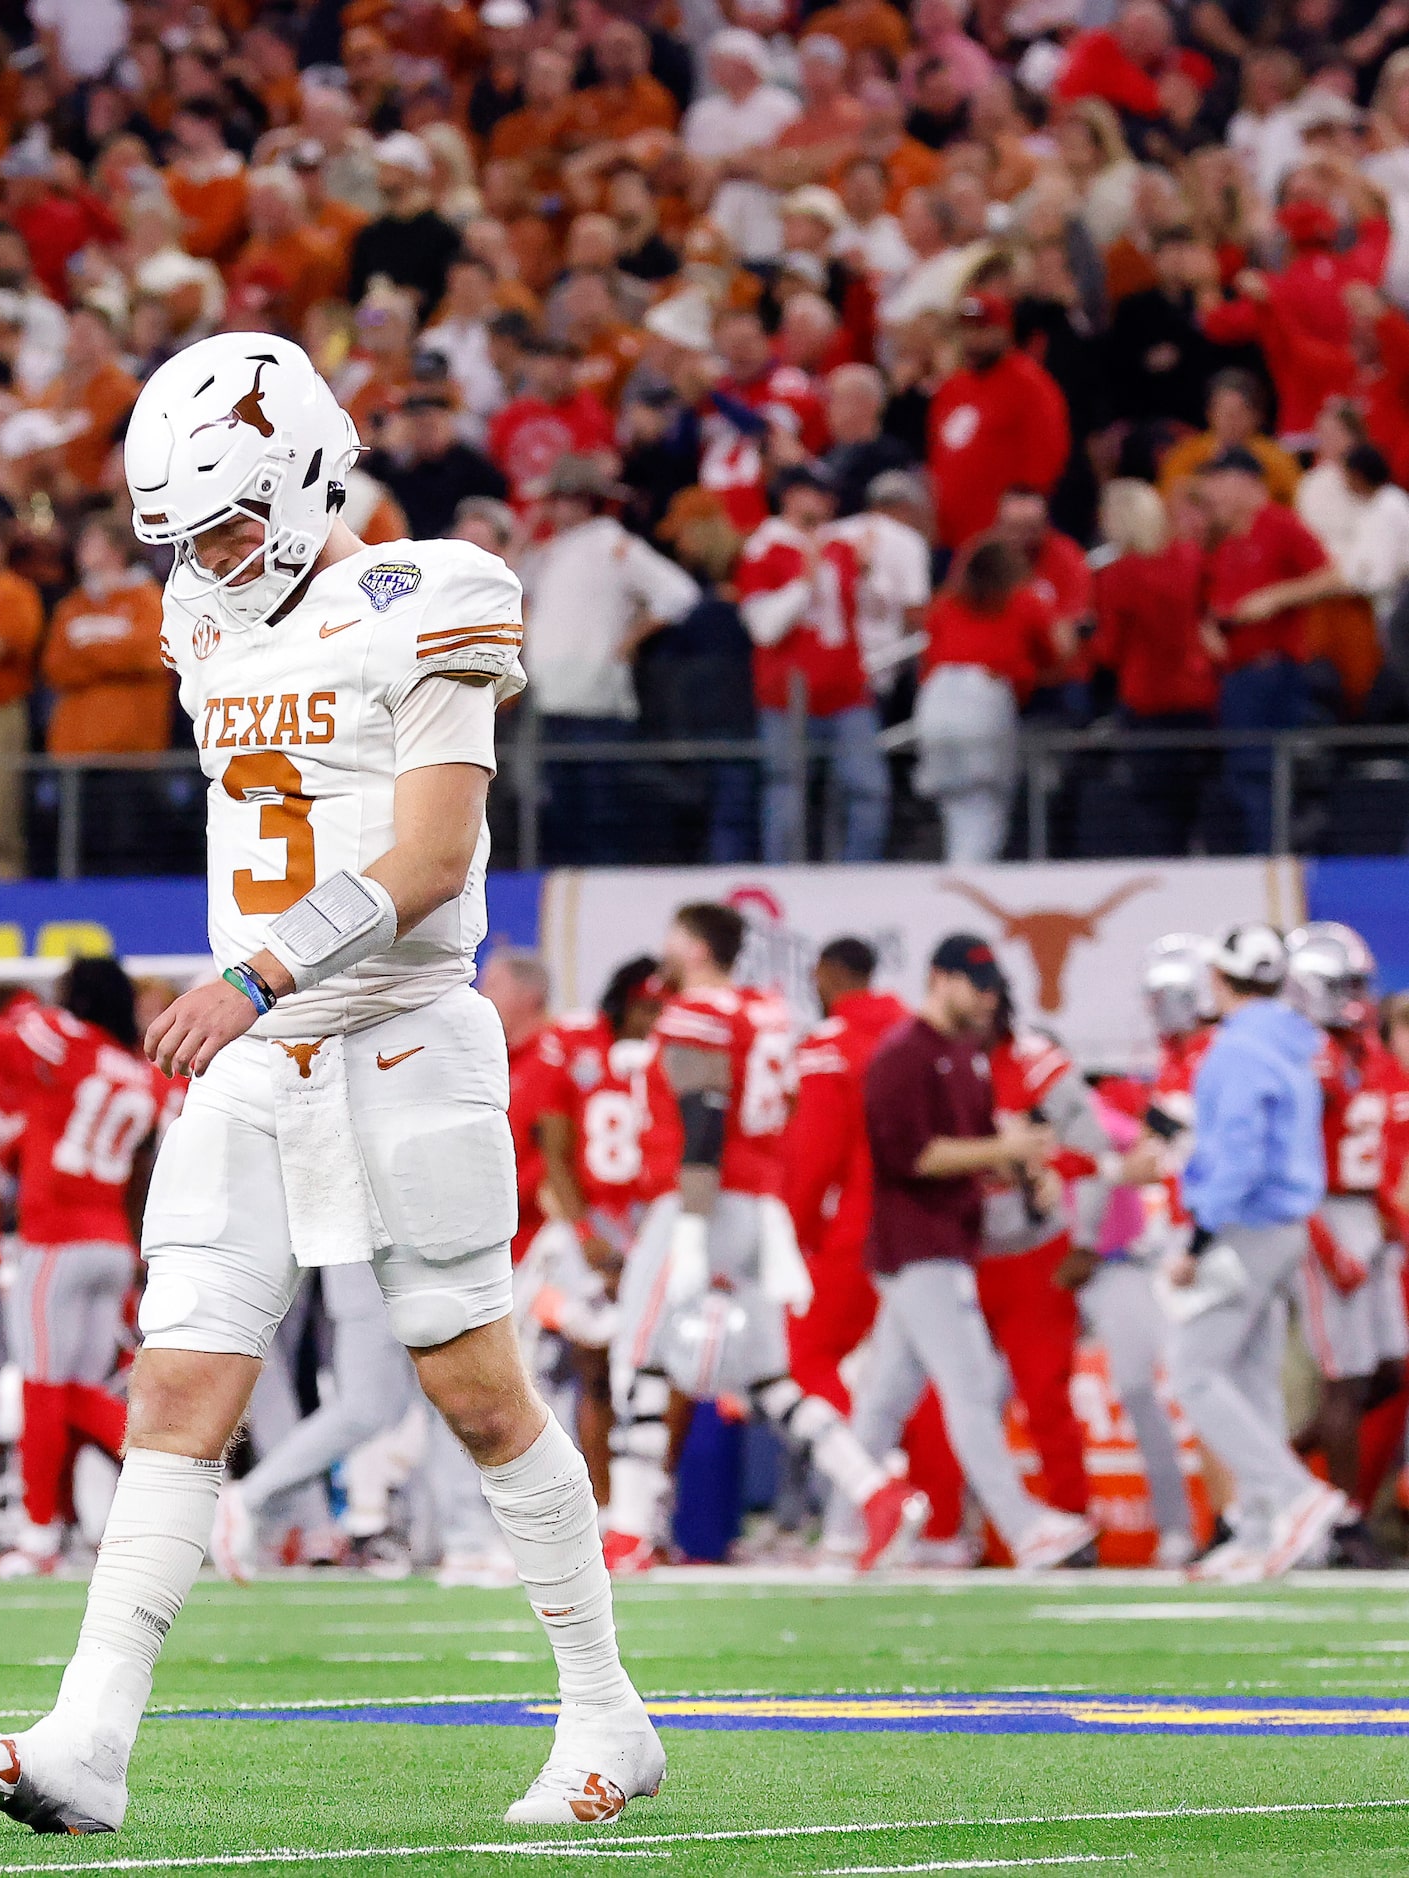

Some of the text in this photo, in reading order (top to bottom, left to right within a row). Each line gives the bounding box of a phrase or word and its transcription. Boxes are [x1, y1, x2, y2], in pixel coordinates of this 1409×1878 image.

[362, 571, 417, 590] COTTON
[370, 580, 404, 592] BOWL
[193, 620, 220, 658] SEC
[202, 692, 336, 749] TEXAS
[222, 751, 316, 915] 3
[52, 1075, 156, 1184] 10
